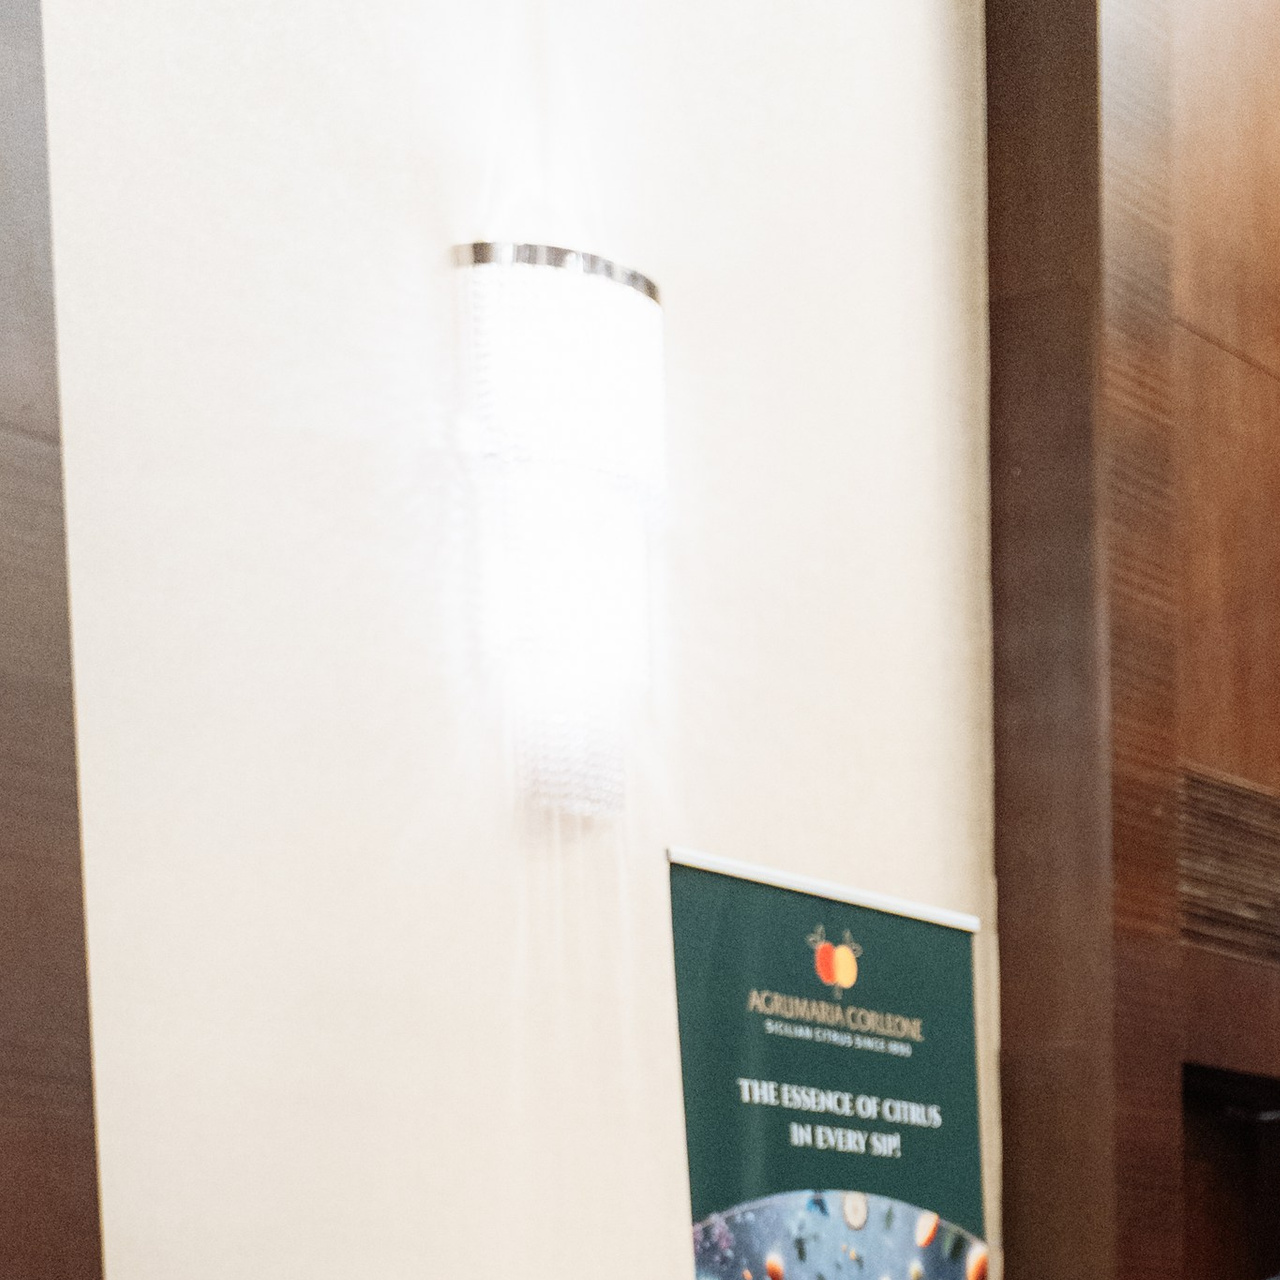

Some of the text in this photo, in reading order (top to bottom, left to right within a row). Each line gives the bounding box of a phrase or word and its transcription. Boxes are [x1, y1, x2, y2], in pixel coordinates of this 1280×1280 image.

[748, 988, 924, 1042] AGRUMARIA CORLEONE
[738, 1077, 943, 1129] THE ESSENCE OF CITRUS
[789, 1122, 902, 1159] IN EVERY SIP!
